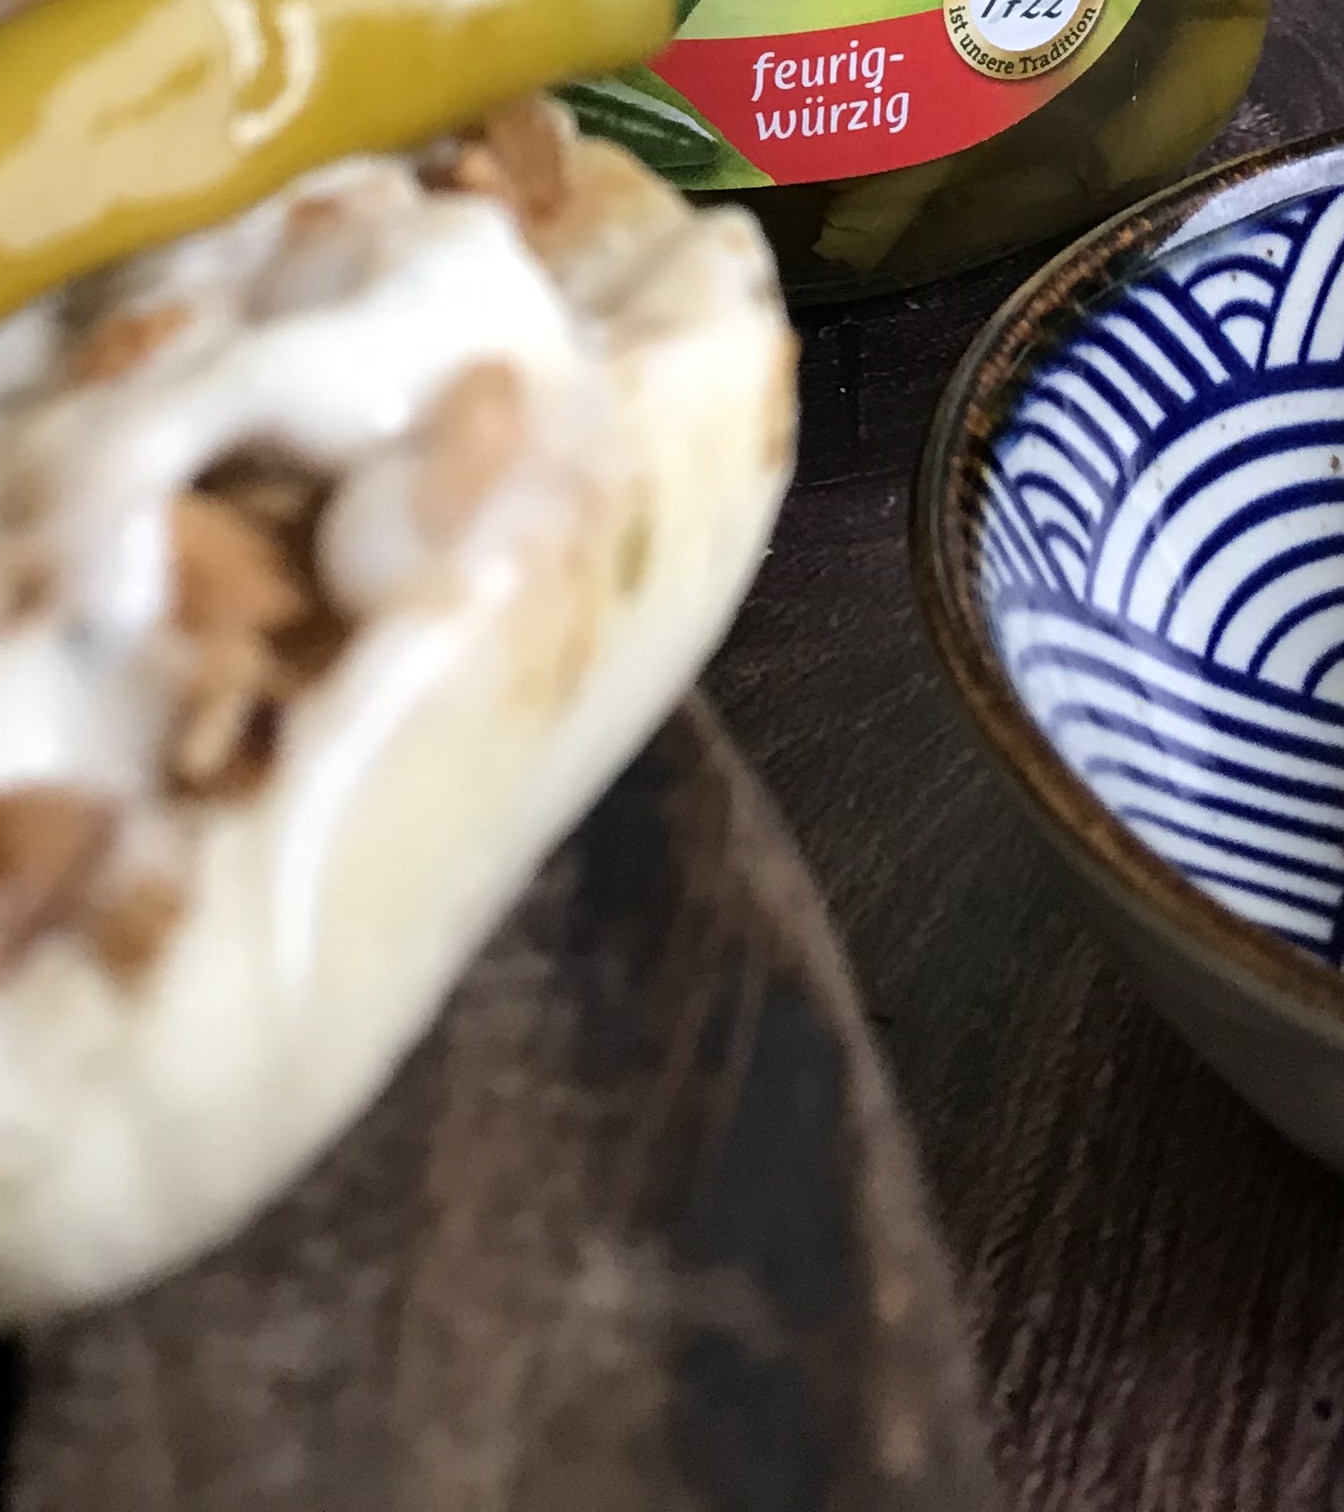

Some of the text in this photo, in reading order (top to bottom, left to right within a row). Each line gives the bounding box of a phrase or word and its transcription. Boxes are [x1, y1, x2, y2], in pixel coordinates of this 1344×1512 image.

[750, 39, 905, 102] feurig-
[948, 4, 1098, 75] ist unsere Tradition
[755, 86, 910, 142] würzig
